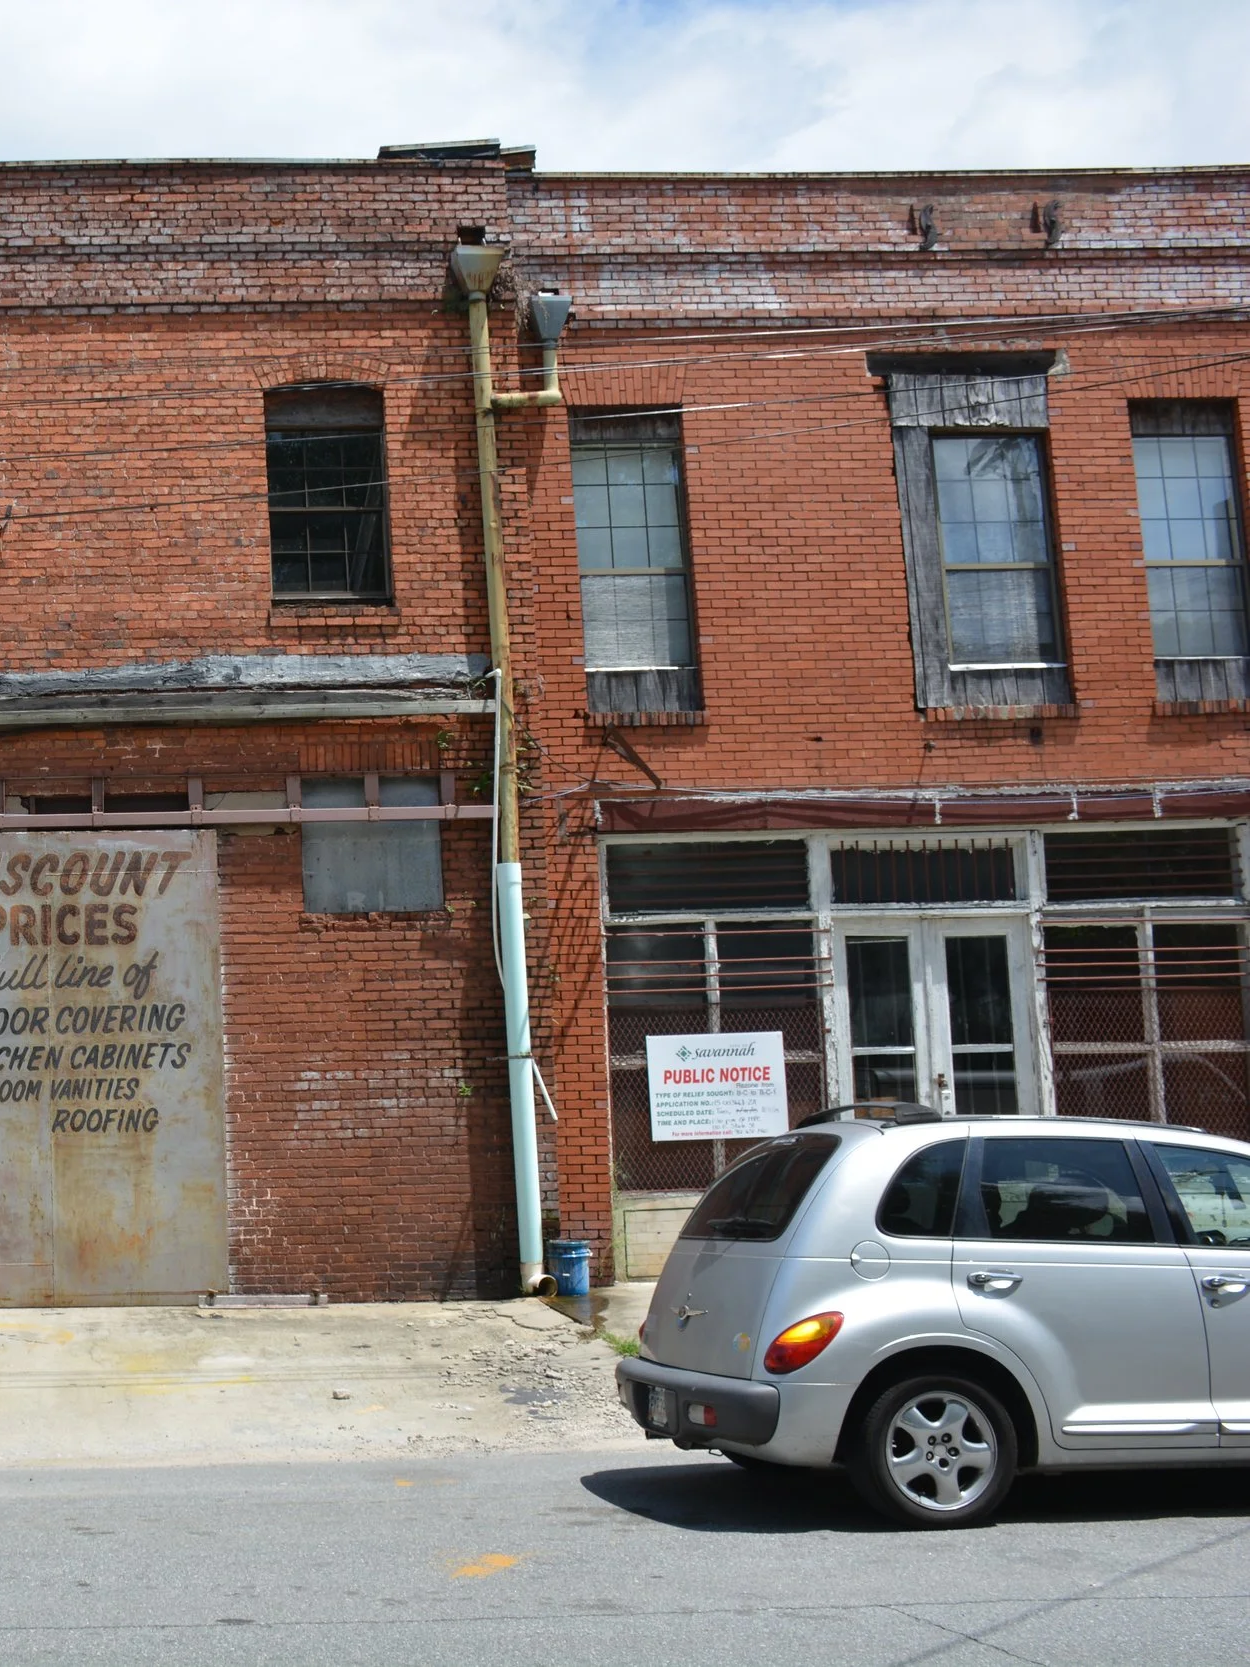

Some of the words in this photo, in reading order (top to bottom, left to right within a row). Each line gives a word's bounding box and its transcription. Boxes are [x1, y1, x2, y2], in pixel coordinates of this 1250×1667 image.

[54, 955, 114, 989] line
[123, 950, 159, 1000] of
[55, 1003, 187, 1035] COVERING
[70, 1042, 192, 1070] CABINETS
[663, 1068, 715, 1084] PUBLIC
[720, 1066, 771, 1082] NOTICE
[50, 1077, 140, 1101] VANITIES
[51, 1107, 159, 1134] ROOFING
